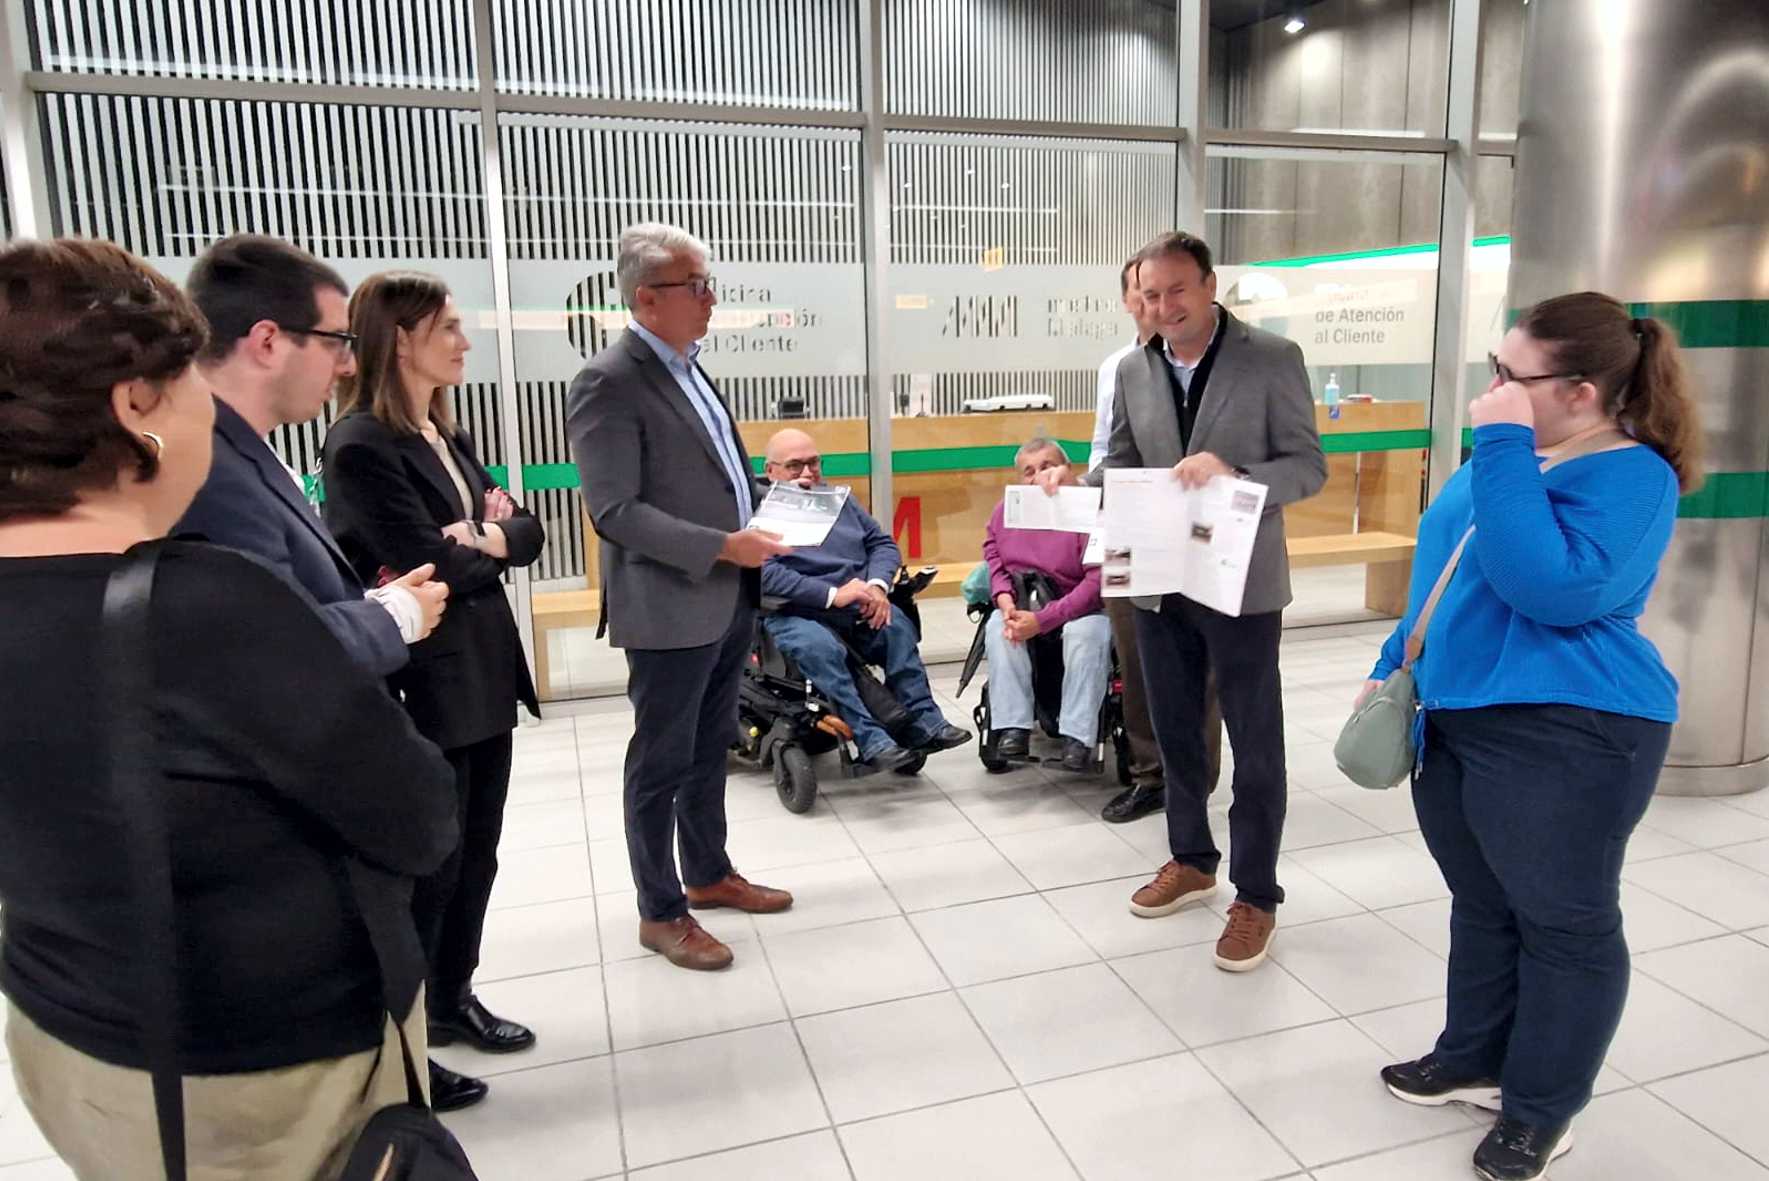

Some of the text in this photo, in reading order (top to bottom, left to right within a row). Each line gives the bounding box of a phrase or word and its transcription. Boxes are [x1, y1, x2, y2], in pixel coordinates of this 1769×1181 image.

[1338, 305, 1405, 323] Atención
[1314, 328, 1385, 344] al Cliente
